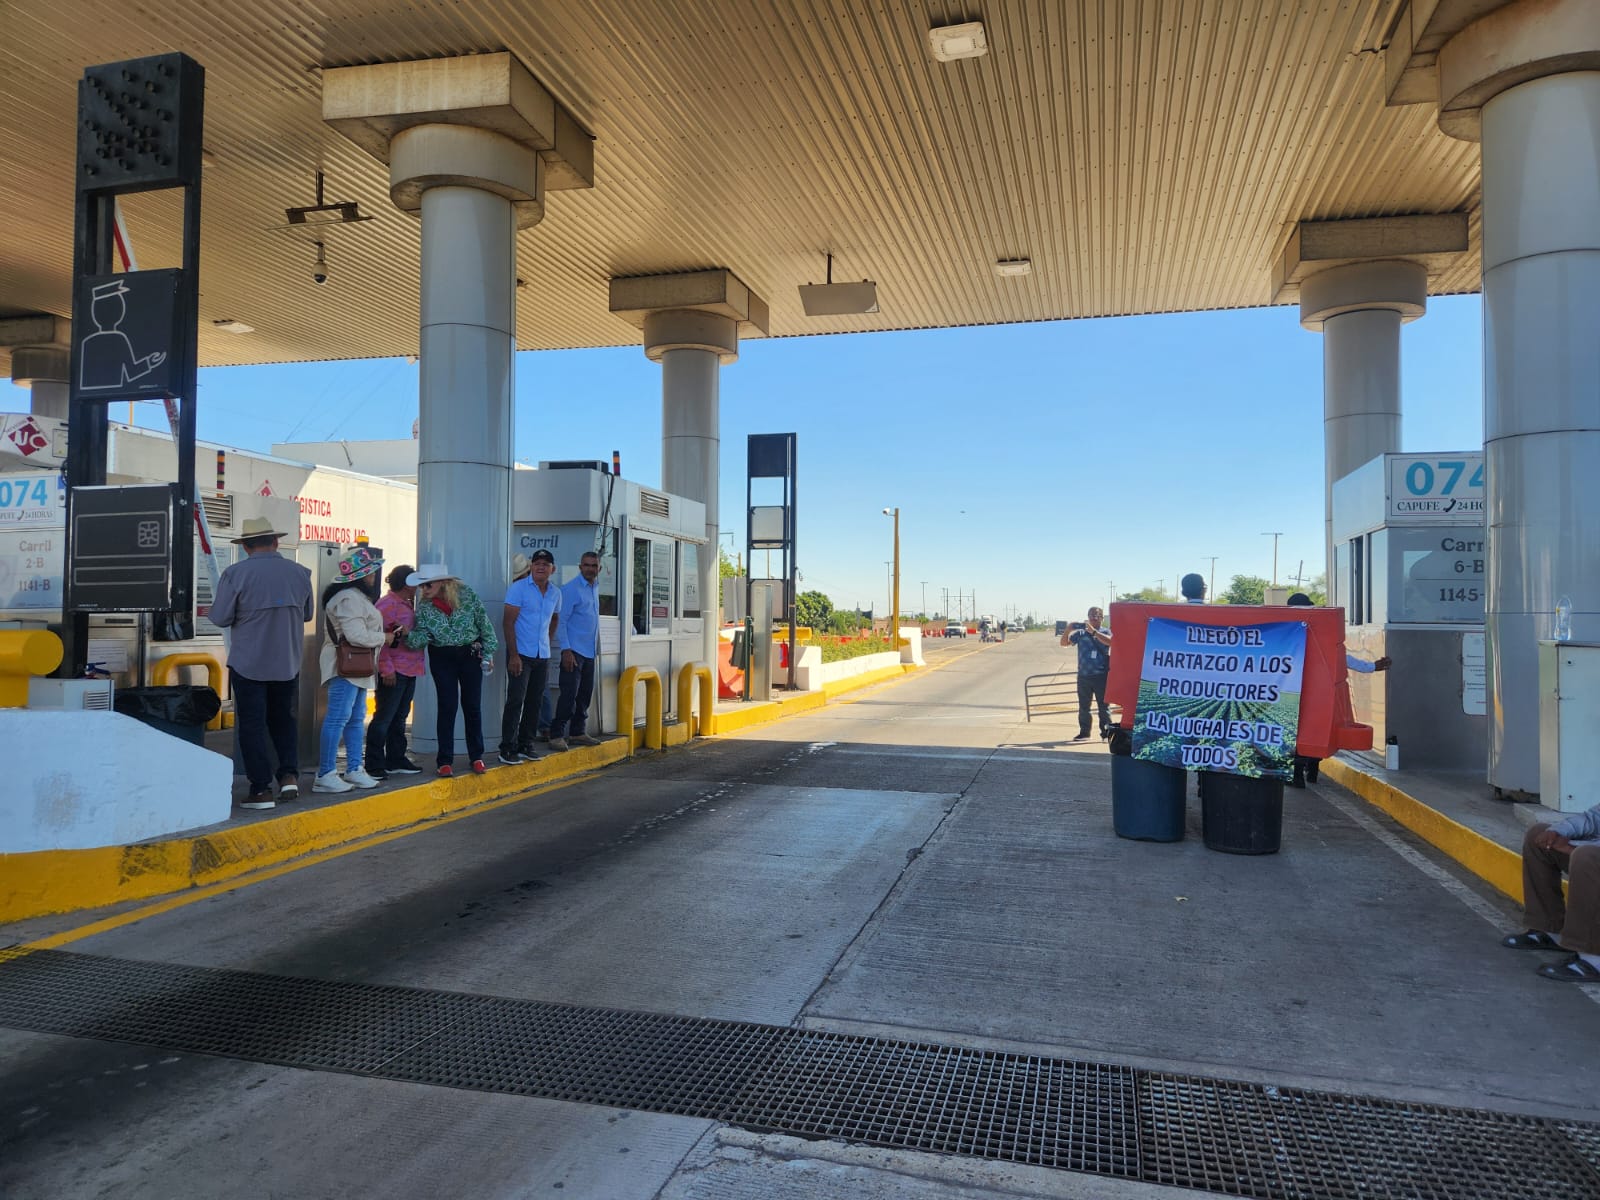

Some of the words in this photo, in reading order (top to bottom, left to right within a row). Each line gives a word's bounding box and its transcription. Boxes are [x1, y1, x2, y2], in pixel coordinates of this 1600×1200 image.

[0, 479, 48, 508] 074
[32, 510, 53, 519] HORAS
[289, 496, 332, 517] GISTICA
[1397, 501, 1440, 511] CAPUFE
[1457, 502, 1469, 511] 24
[305, 524, 351, 544] DINAMICOS
[520, 534, 559, 548] Carril
[19, 540, 52, 552] Carril
[26, 558, 45, 569] 2-B
[1454, 560, 1484, 573] 6-B
[19, 579, 51, 592] 1141-B
[1187, 626, 1239, 645] LLEGÓ
[1244, 629, 1263, 646] EL
[1152, 650, 1238, 672] HARTAZGO
[1243, 656, 1254, 673] A
[1259, 656, 1292, 674] LOS
[1158, 677, 1279, 701] PRODUCTORES
[1149, 712, 1168, 731] LA
[1174, 717, 1223, 737] LUCHA
[1228, 722, 1251, 739] ES
[1256, 725, 1282, 744] DE
[1182, 746, 1237, 766] TODOS
